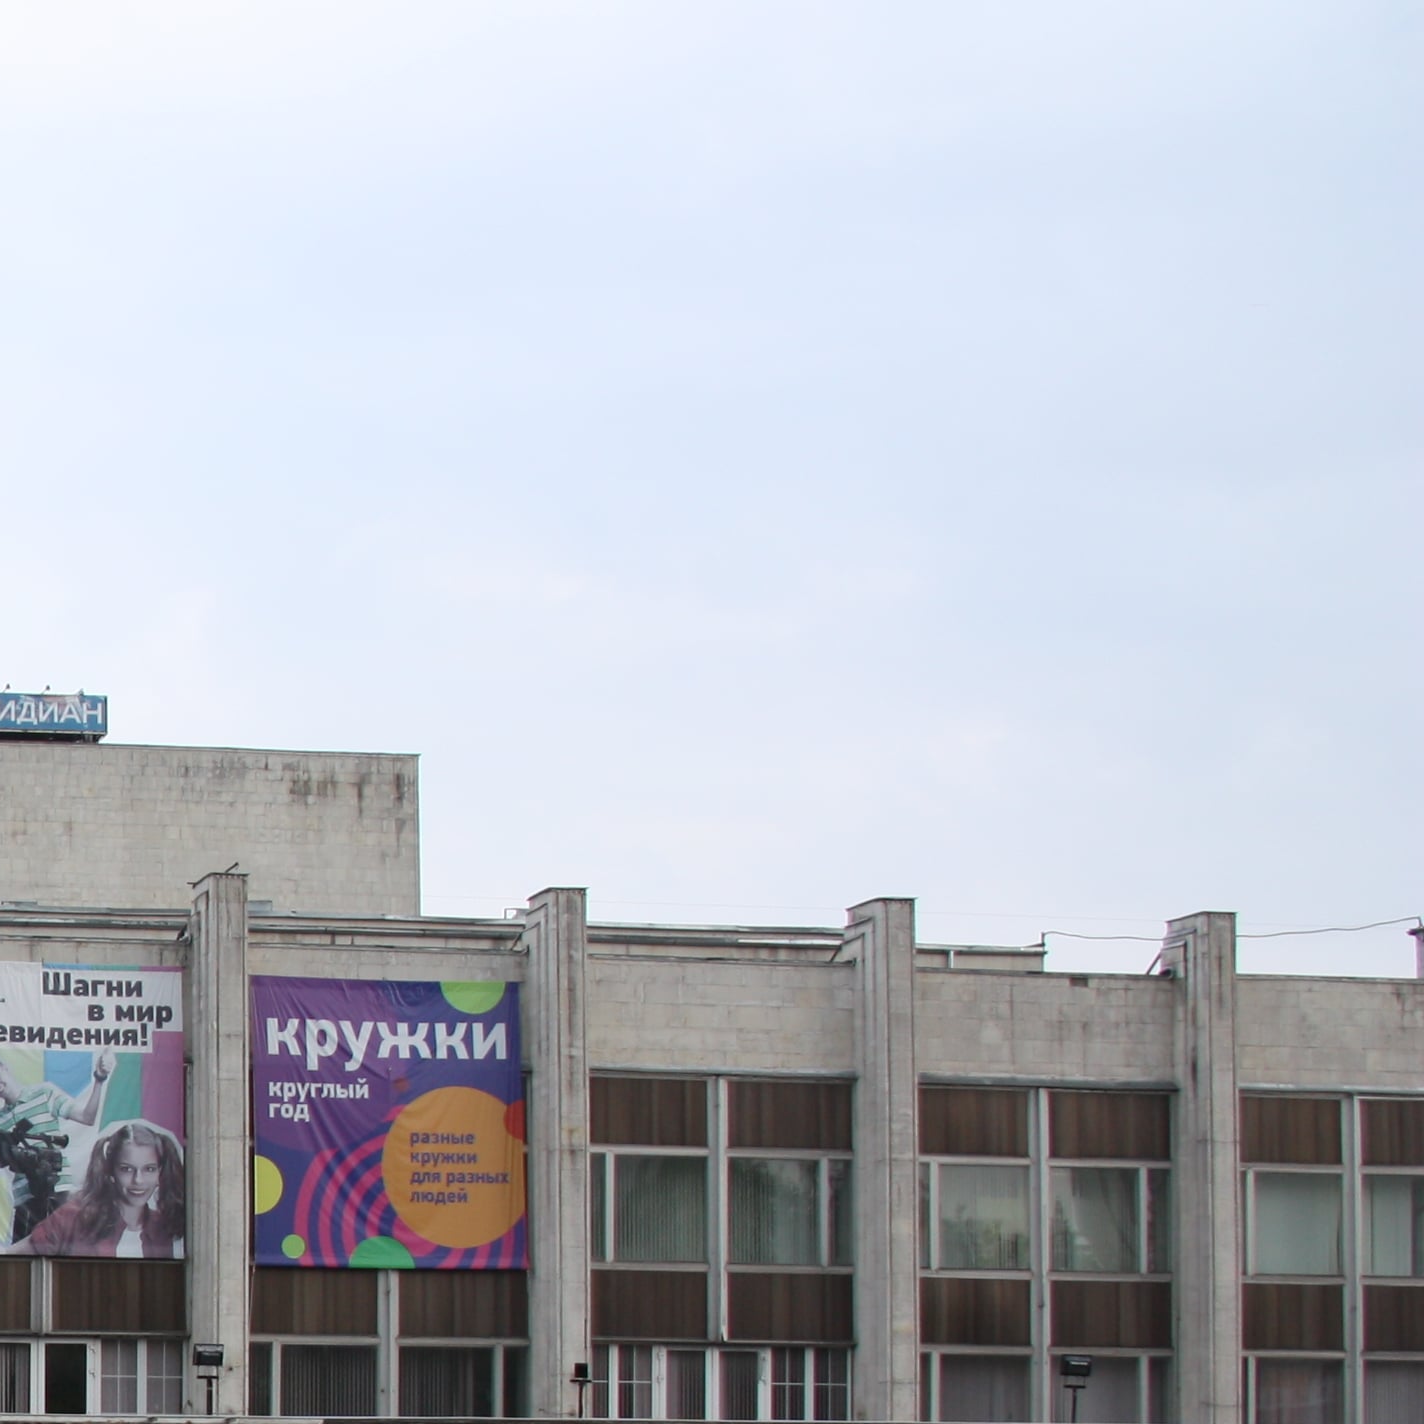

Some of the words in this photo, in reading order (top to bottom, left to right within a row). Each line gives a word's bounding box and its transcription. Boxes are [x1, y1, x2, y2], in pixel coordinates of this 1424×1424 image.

[42, 971, 143, 997] Шагни
[88, 1005, 105, 1021] в
[116, 1005, 173, 1028] мир
[265, 1018, 507, 1071] кружки
[269, 1078, 369, 1102] круглый
[269, 1103, 310, 1122] год
[410, 1132, 475, 1147] разные
[410, 1152, 477, 1167] кружки
[410, 1172, 441, 1185] для
[446, 1172, 509, 1187] разных
[410, 1187, 468, 1205] людей
